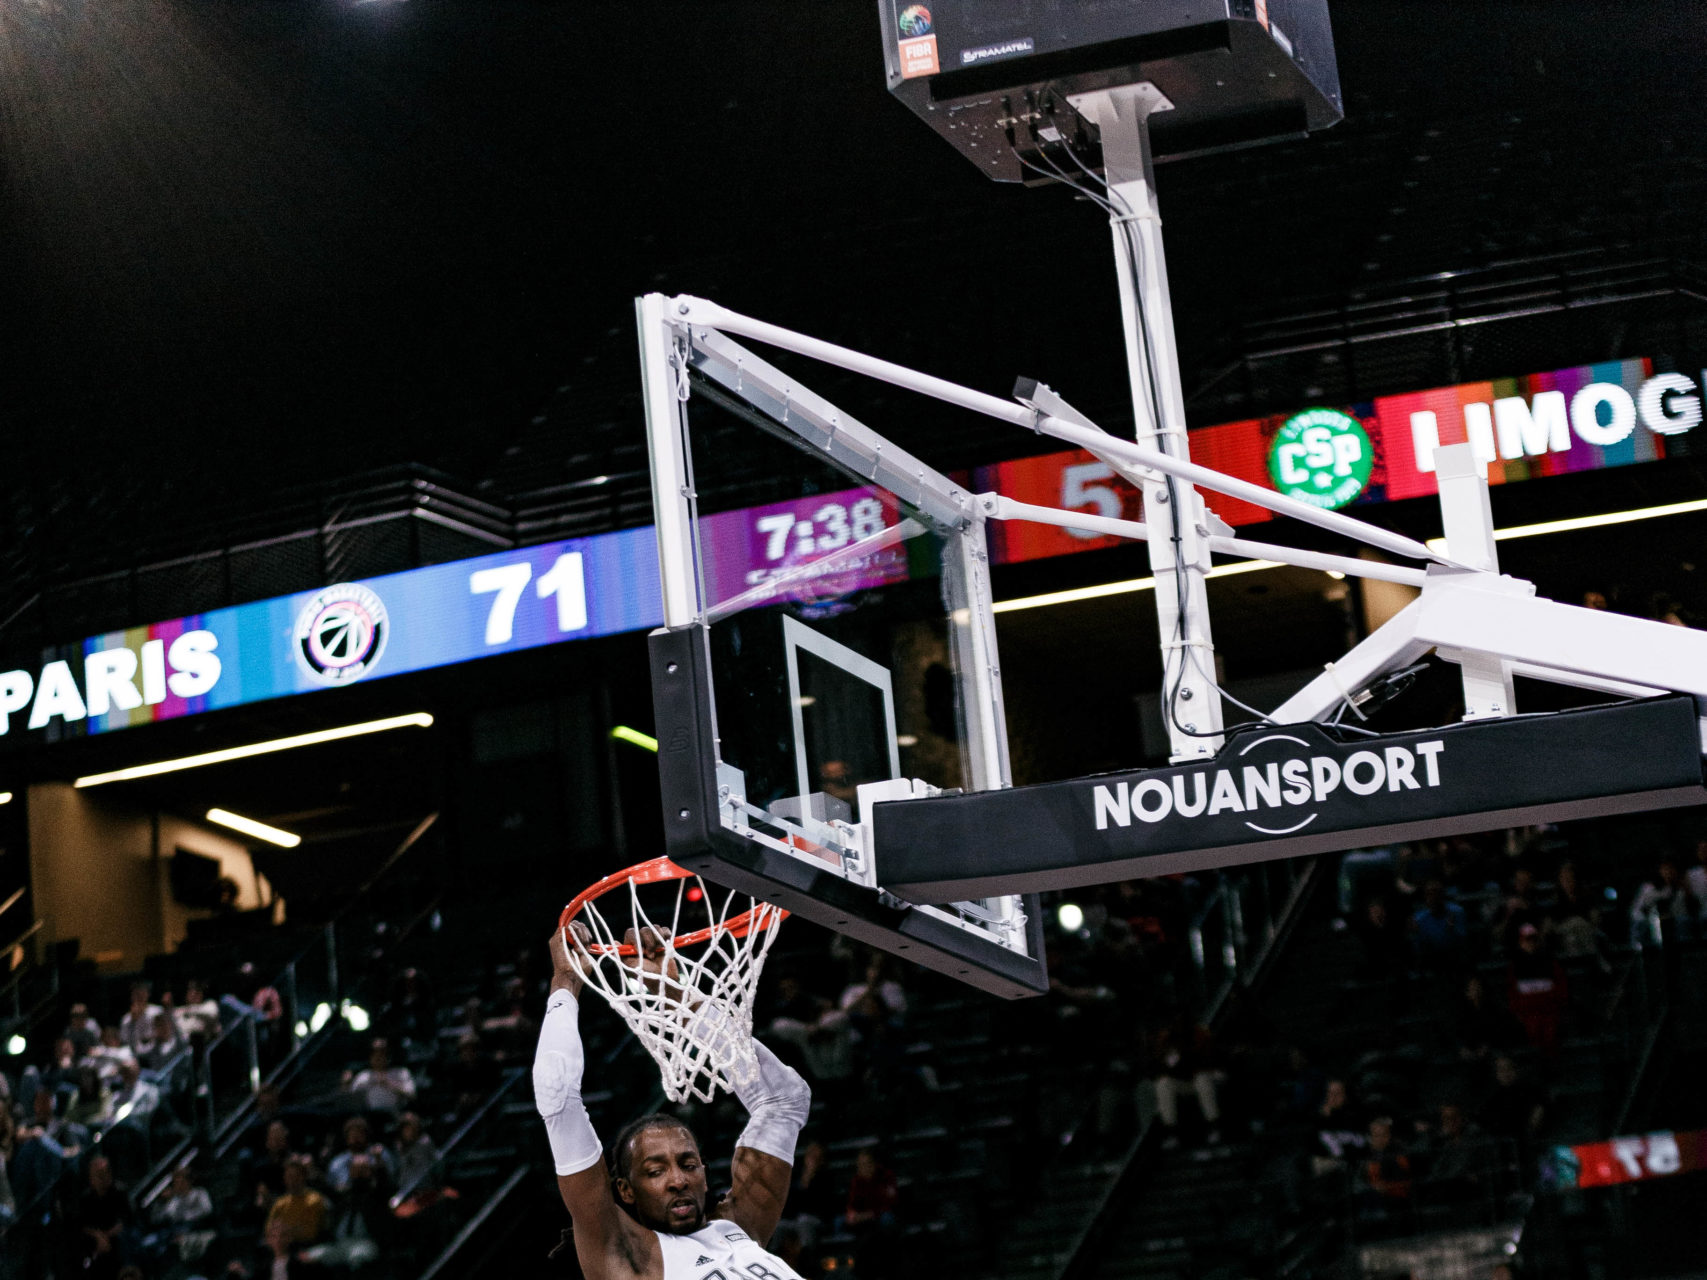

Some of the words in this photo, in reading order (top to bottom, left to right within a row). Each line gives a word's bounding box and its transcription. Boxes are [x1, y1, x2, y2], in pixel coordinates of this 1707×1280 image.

[905, 42, 932, 59] FIBA
[963, 42, 1032, 63] STRAMATEL
[1278, 426, 1362, 485] CSP
[1410, 371, 1707, 473] LIMOG
[757, 497, 887, 561] 7:38
[469, 551, 588, 646] 71
[0, 629, 222, 735] PARIS
[1094, 740, 1445, 831] NOUANSPORT
